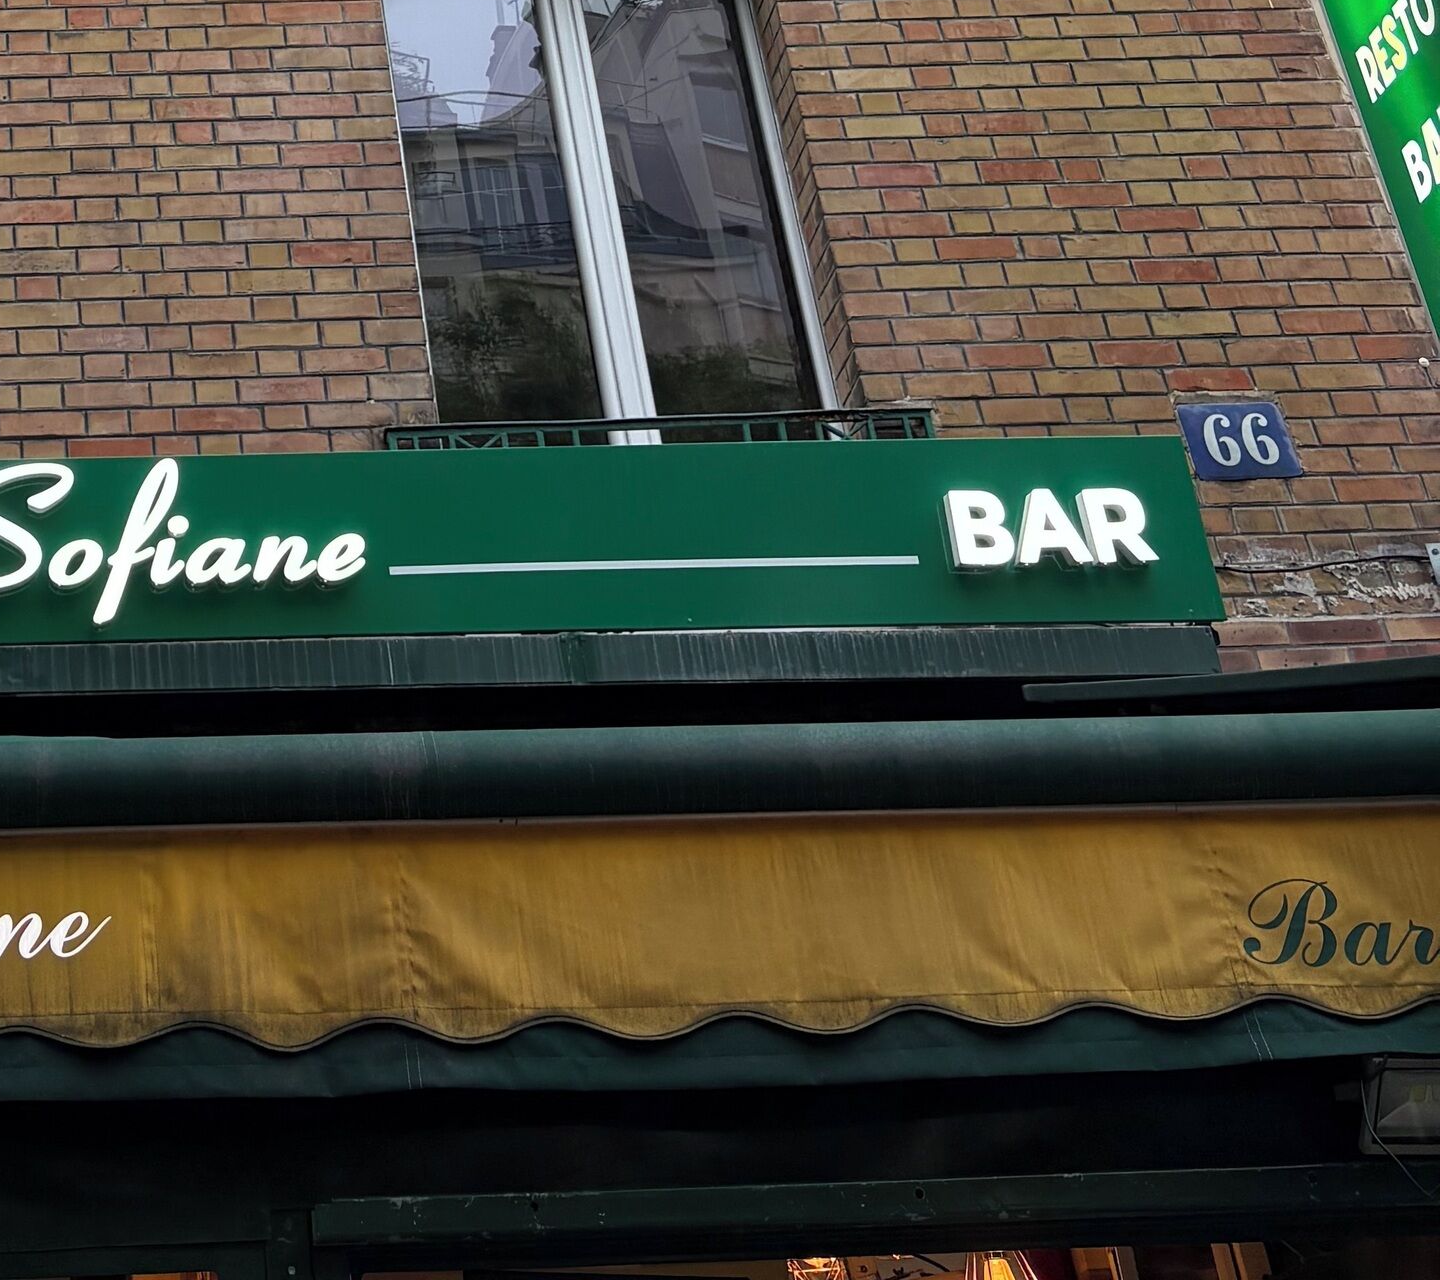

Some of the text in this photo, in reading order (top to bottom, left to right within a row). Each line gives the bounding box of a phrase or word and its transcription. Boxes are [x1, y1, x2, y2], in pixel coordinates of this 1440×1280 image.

[1401, 104, 1440, 204] BA
[1203, 413, 1280, 467] 66
[944, 487, 1160, 568] BAR
[1243, 878, 1440, 968] Bar
